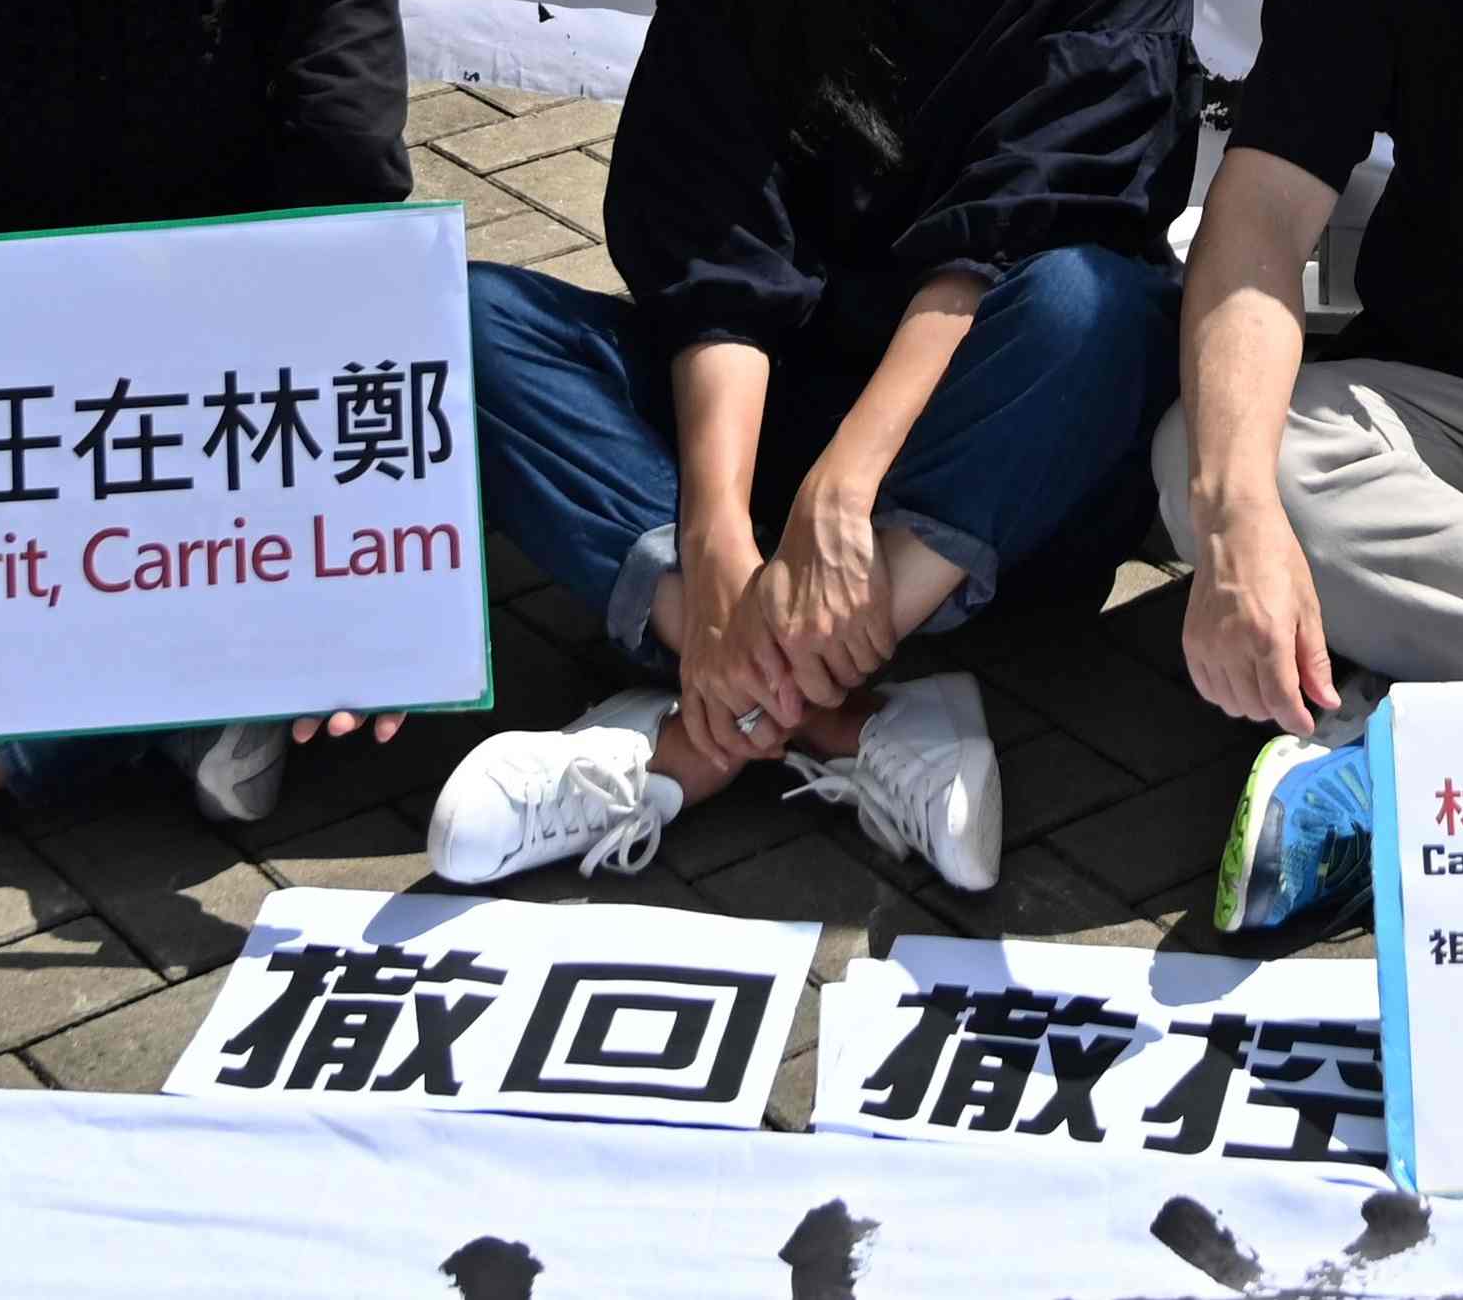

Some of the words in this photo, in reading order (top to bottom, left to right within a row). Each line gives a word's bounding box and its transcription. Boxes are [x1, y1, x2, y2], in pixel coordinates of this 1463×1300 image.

[83, 517, 292, 593] Carrie
[314, 515, 461, 578] Lam
[219, 943, 775, 1103] 撤回
